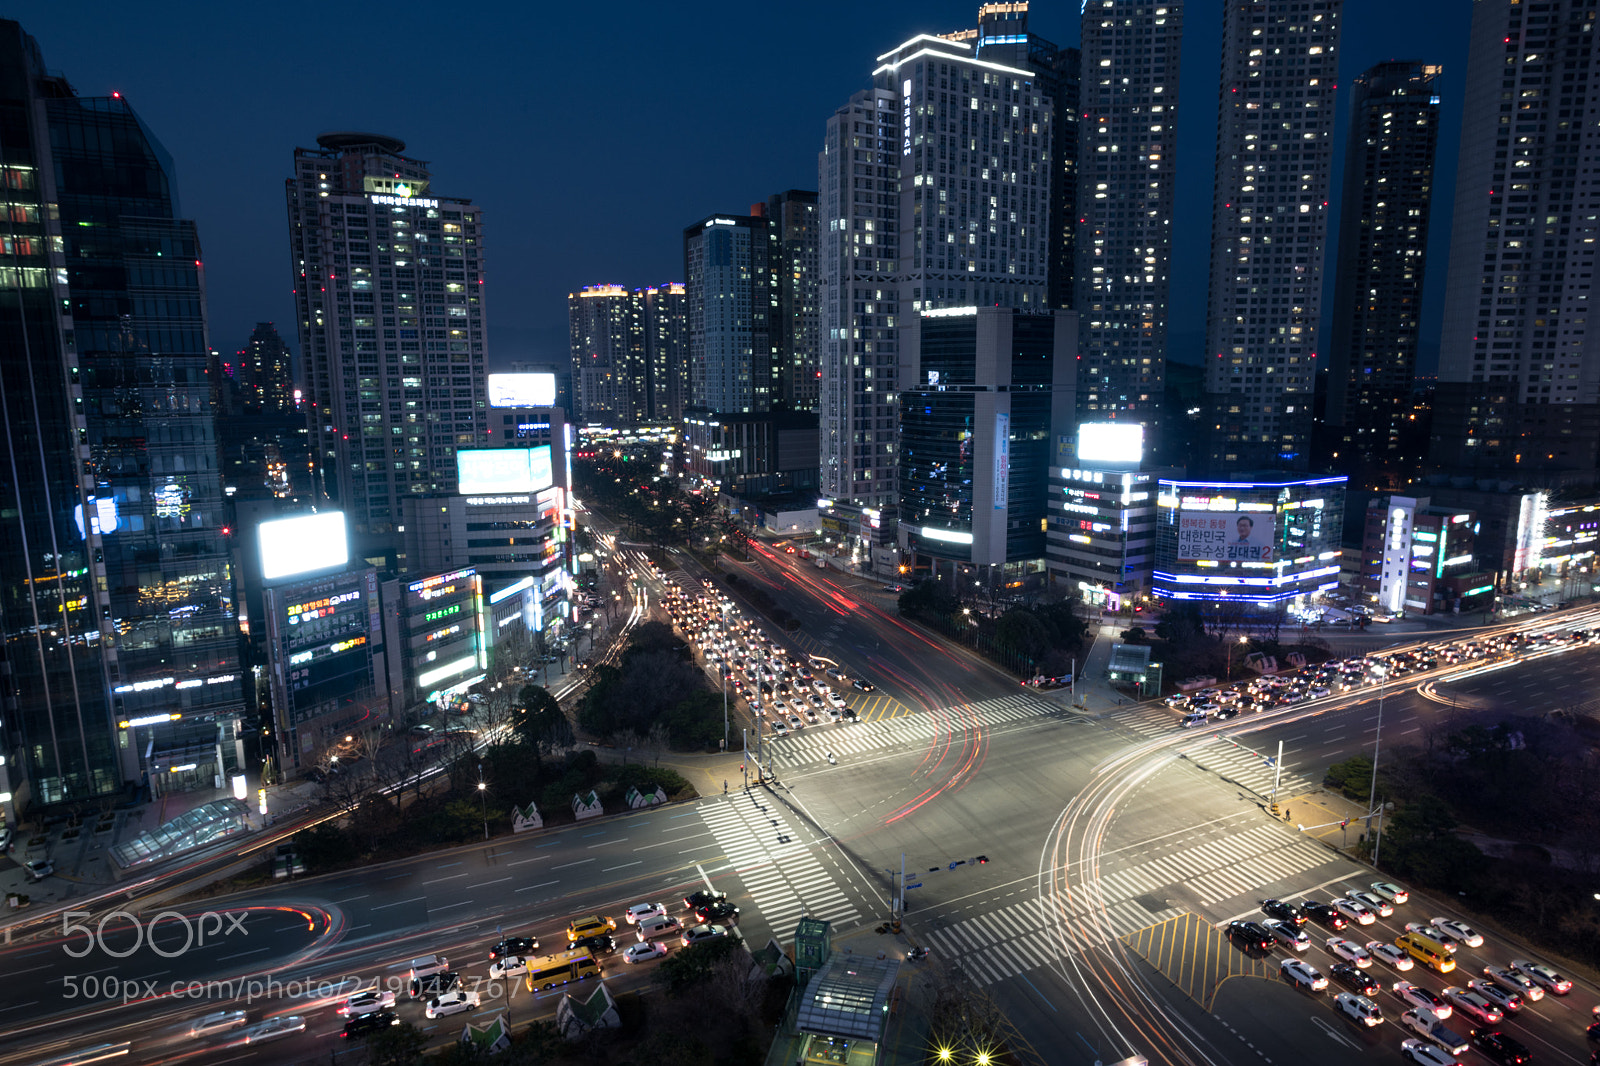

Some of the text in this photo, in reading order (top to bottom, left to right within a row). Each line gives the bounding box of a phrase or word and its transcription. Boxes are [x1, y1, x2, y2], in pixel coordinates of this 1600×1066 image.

[1182, 518, 1226, 529] 행복한 동행
[1180, 530, 1226, 543] 대한민국
[1180, 544, 1271, 559] 일등수성 김대권 2
